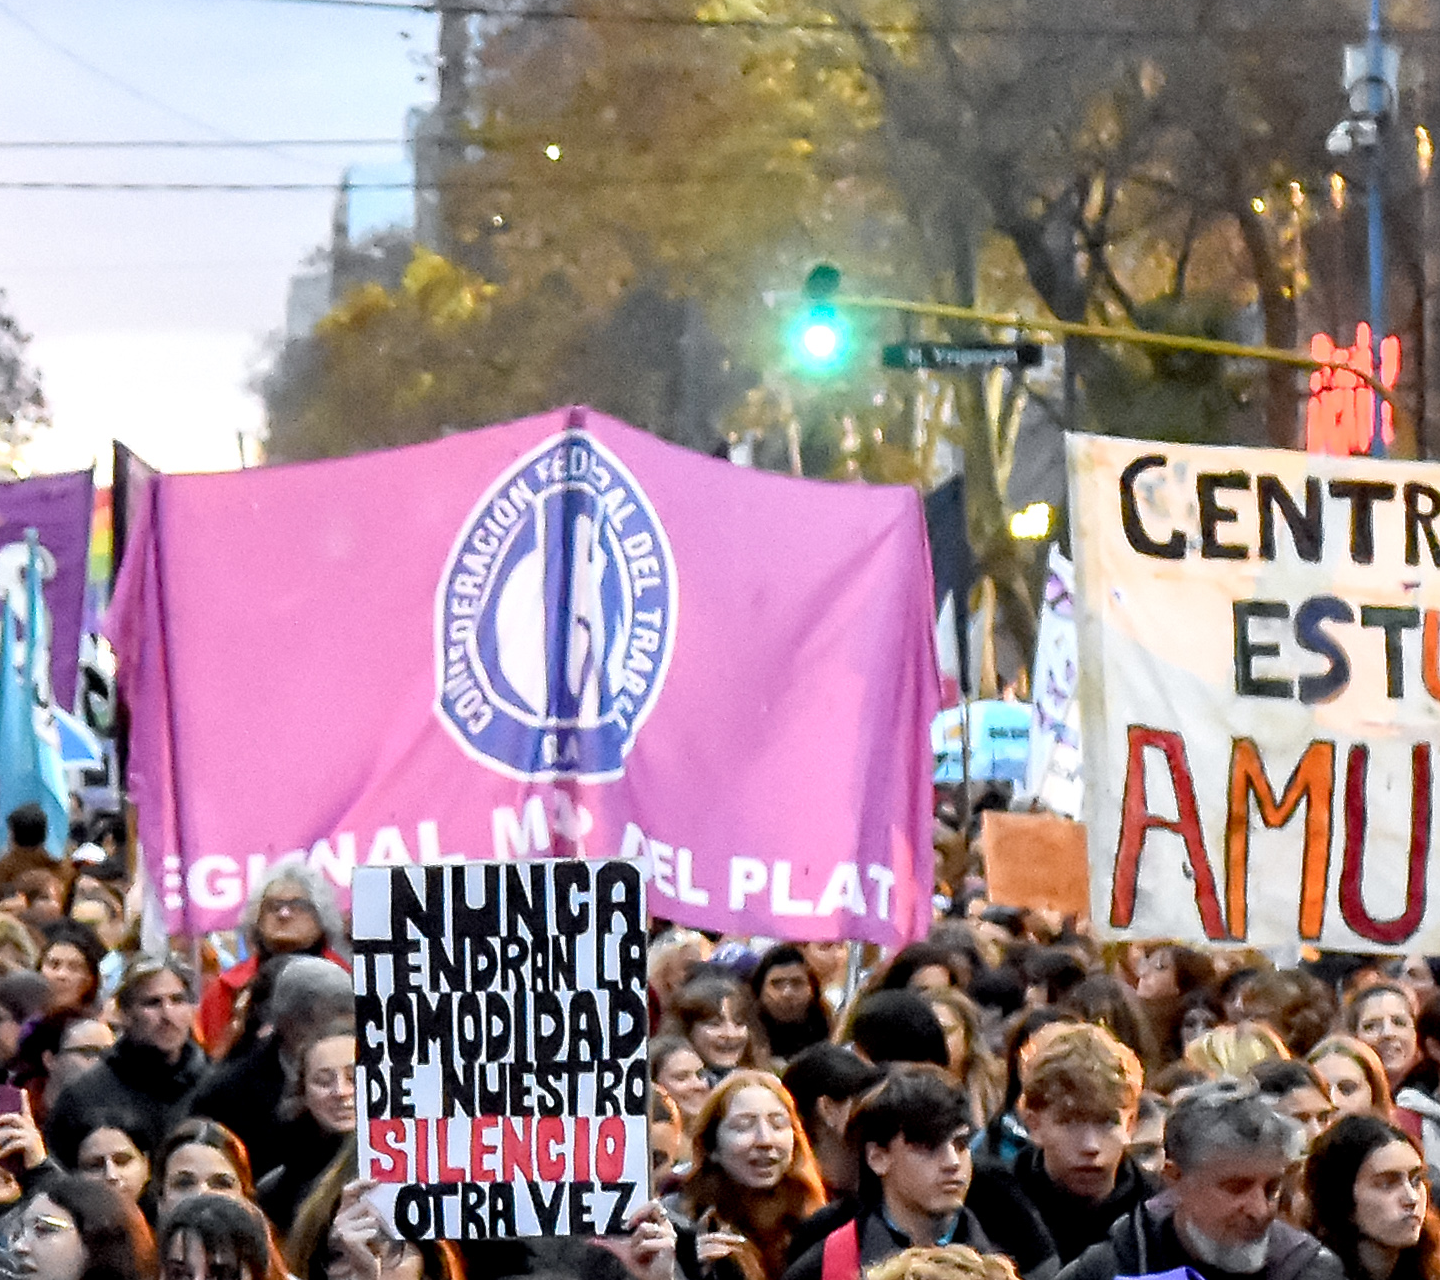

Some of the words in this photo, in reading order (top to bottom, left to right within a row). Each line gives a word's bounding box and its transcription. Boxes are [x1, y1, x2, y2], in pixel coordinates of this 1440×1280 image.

[623, 531, 662, 597] DEL
[390, 861, 642, 939] NUNCA
[728, 854, 896, 921] PLAT
[596, 933, 646, 992] LA
[355, 990, 647, 1065] COMODIDAD
[366, 1062, 418, 1118] DE
[442, 1060, 647, 1118] NUESTRO
[368, 1116, 627, 1183] SILENCIO
[394, 1183, 518, 1240] OTRA
[524, 1182, 638, 1237] VEZ
